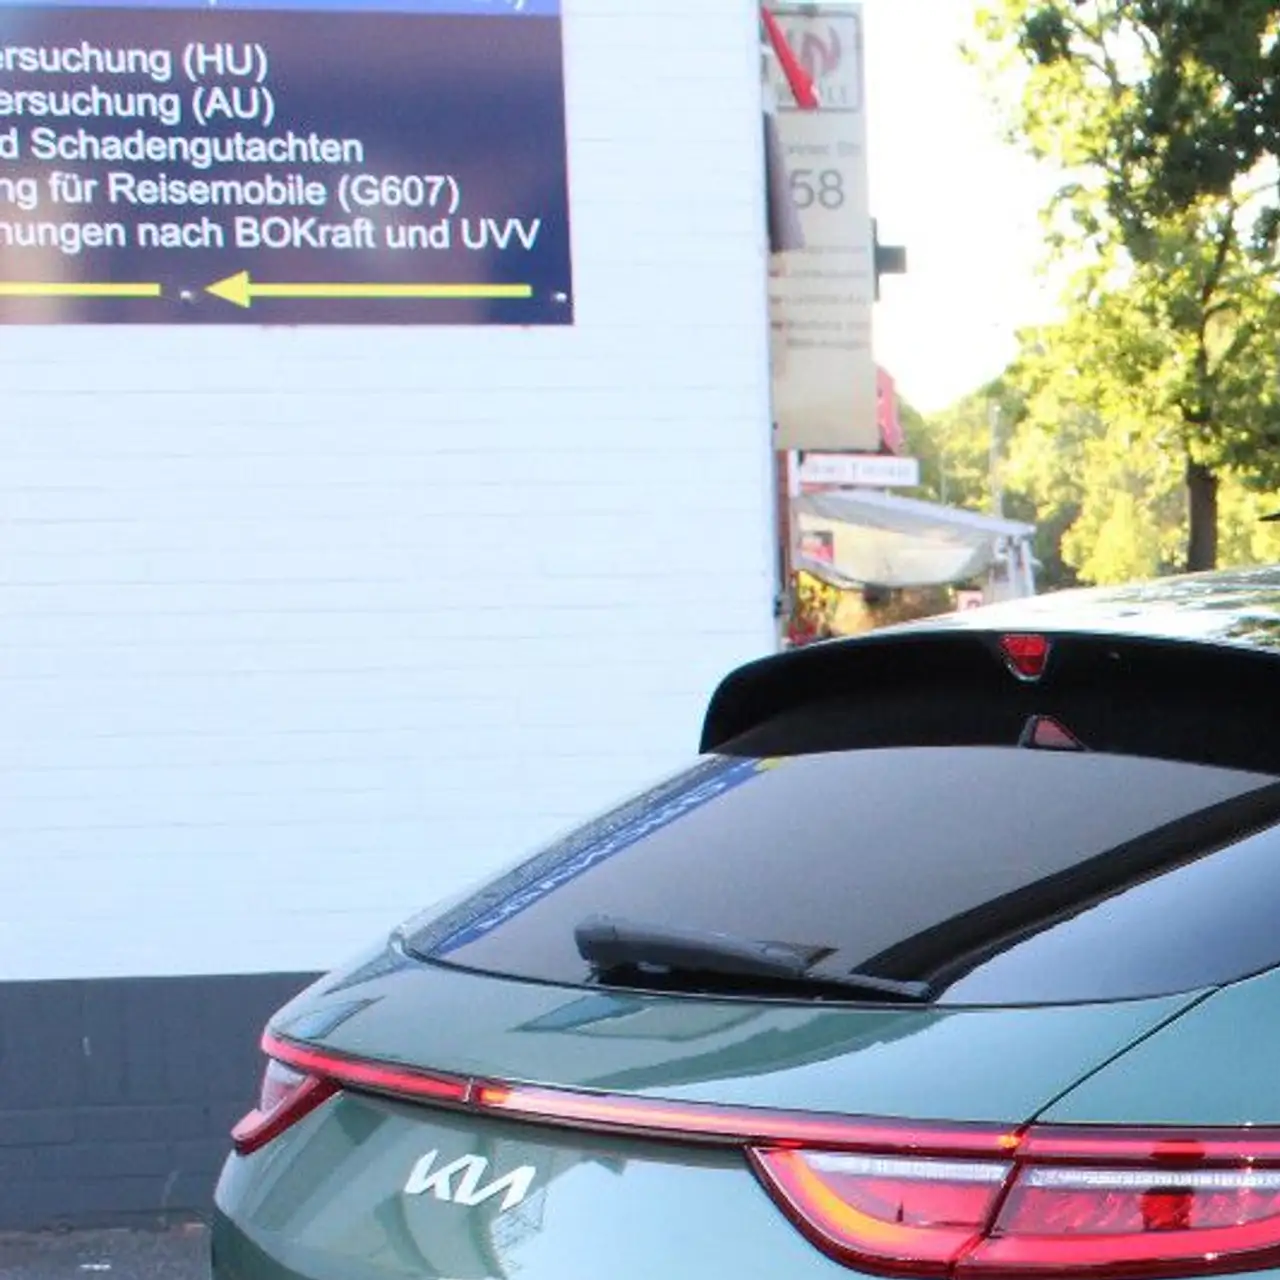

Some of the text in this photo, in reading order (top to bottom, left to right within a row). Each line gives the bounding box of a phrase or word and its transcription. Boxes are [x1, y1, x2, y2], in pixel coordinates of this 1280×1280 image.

[0, 40, 268, 84] rsuchung (HU)
[191, 86, 275, 127] (AU)
[30, 127, 364, 169] Schadengutachten
[48, 171, 98, 203] für
[108, 172, 328, 206] Reisemobile
[338, 174, 460, 214] (G607)
[788, 168, 845, 210] 58
[138, 216, 224, 248] nach
[234, 215, 377, 249] BOKraft
[386, 219, 450, 250] und
[462, 218, 541, 251] UVV
